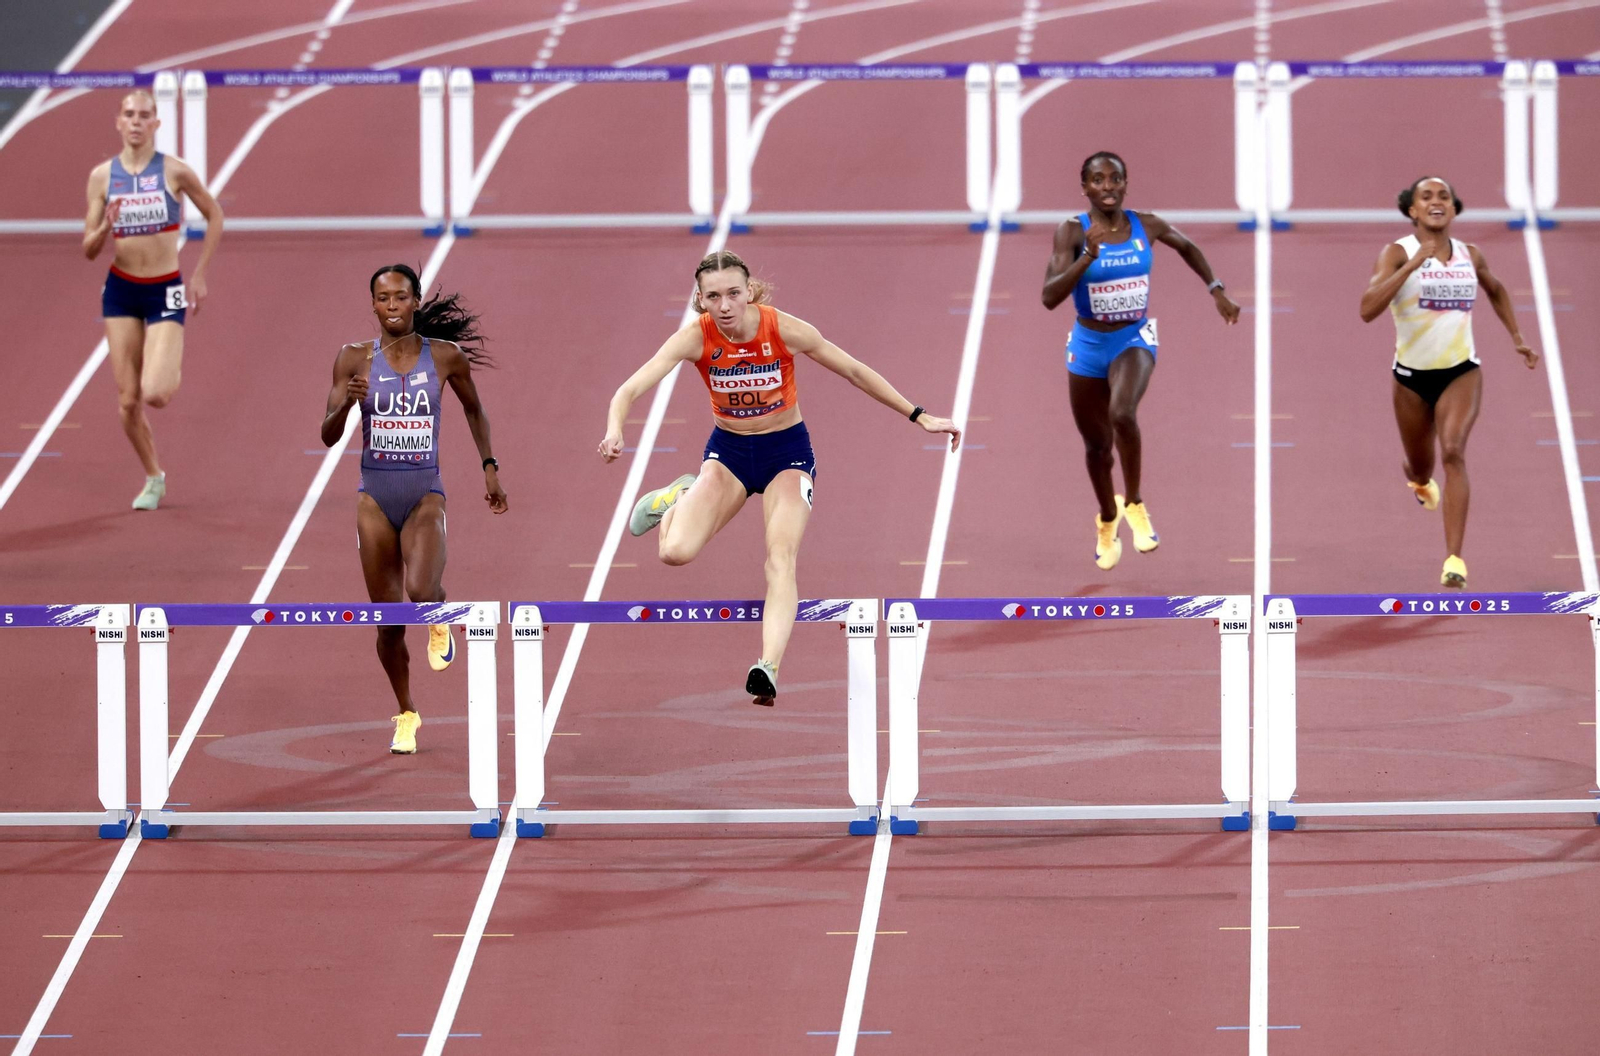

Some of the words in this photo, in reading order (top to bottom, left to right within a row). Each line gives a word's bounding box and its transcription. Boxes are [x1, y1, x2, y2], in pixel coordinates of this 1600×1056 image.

[119, 196, 163, 208] ONDA
[116, 209, 166, 226] EWNHAM
[1101, 255, 1140, 268] ITALIA
[1421, 271, 1474, 280] HONDA
[1090, 279, 1148, 294] HONDA
[172, 290, 182, 307] 8
[1093, 293, 1148, 312] FOLORUNS
[708, 359, 780, 377] Nederland
[711, 376, 780, 389] HONDA
[374, 389, 431, 416] USA
[728, 391, 768, 406] BOL
[372, 419, 432, 430] HONDA
[372, 434, 431, 450] MUHAMMAD
[849, 625, 874, 634] NISHI
[890, 625, 915, 634] NISHI
[1223, 622, 1247, 630] NISHI
[1269, 621, 1293, 630] NISHI
[98, 631, 123, 639] NISHI
[140, 630, 165, 639] NISHI
[469, 628, 494, 636] NISHI
[515, 628, 540, 636] NISHI
